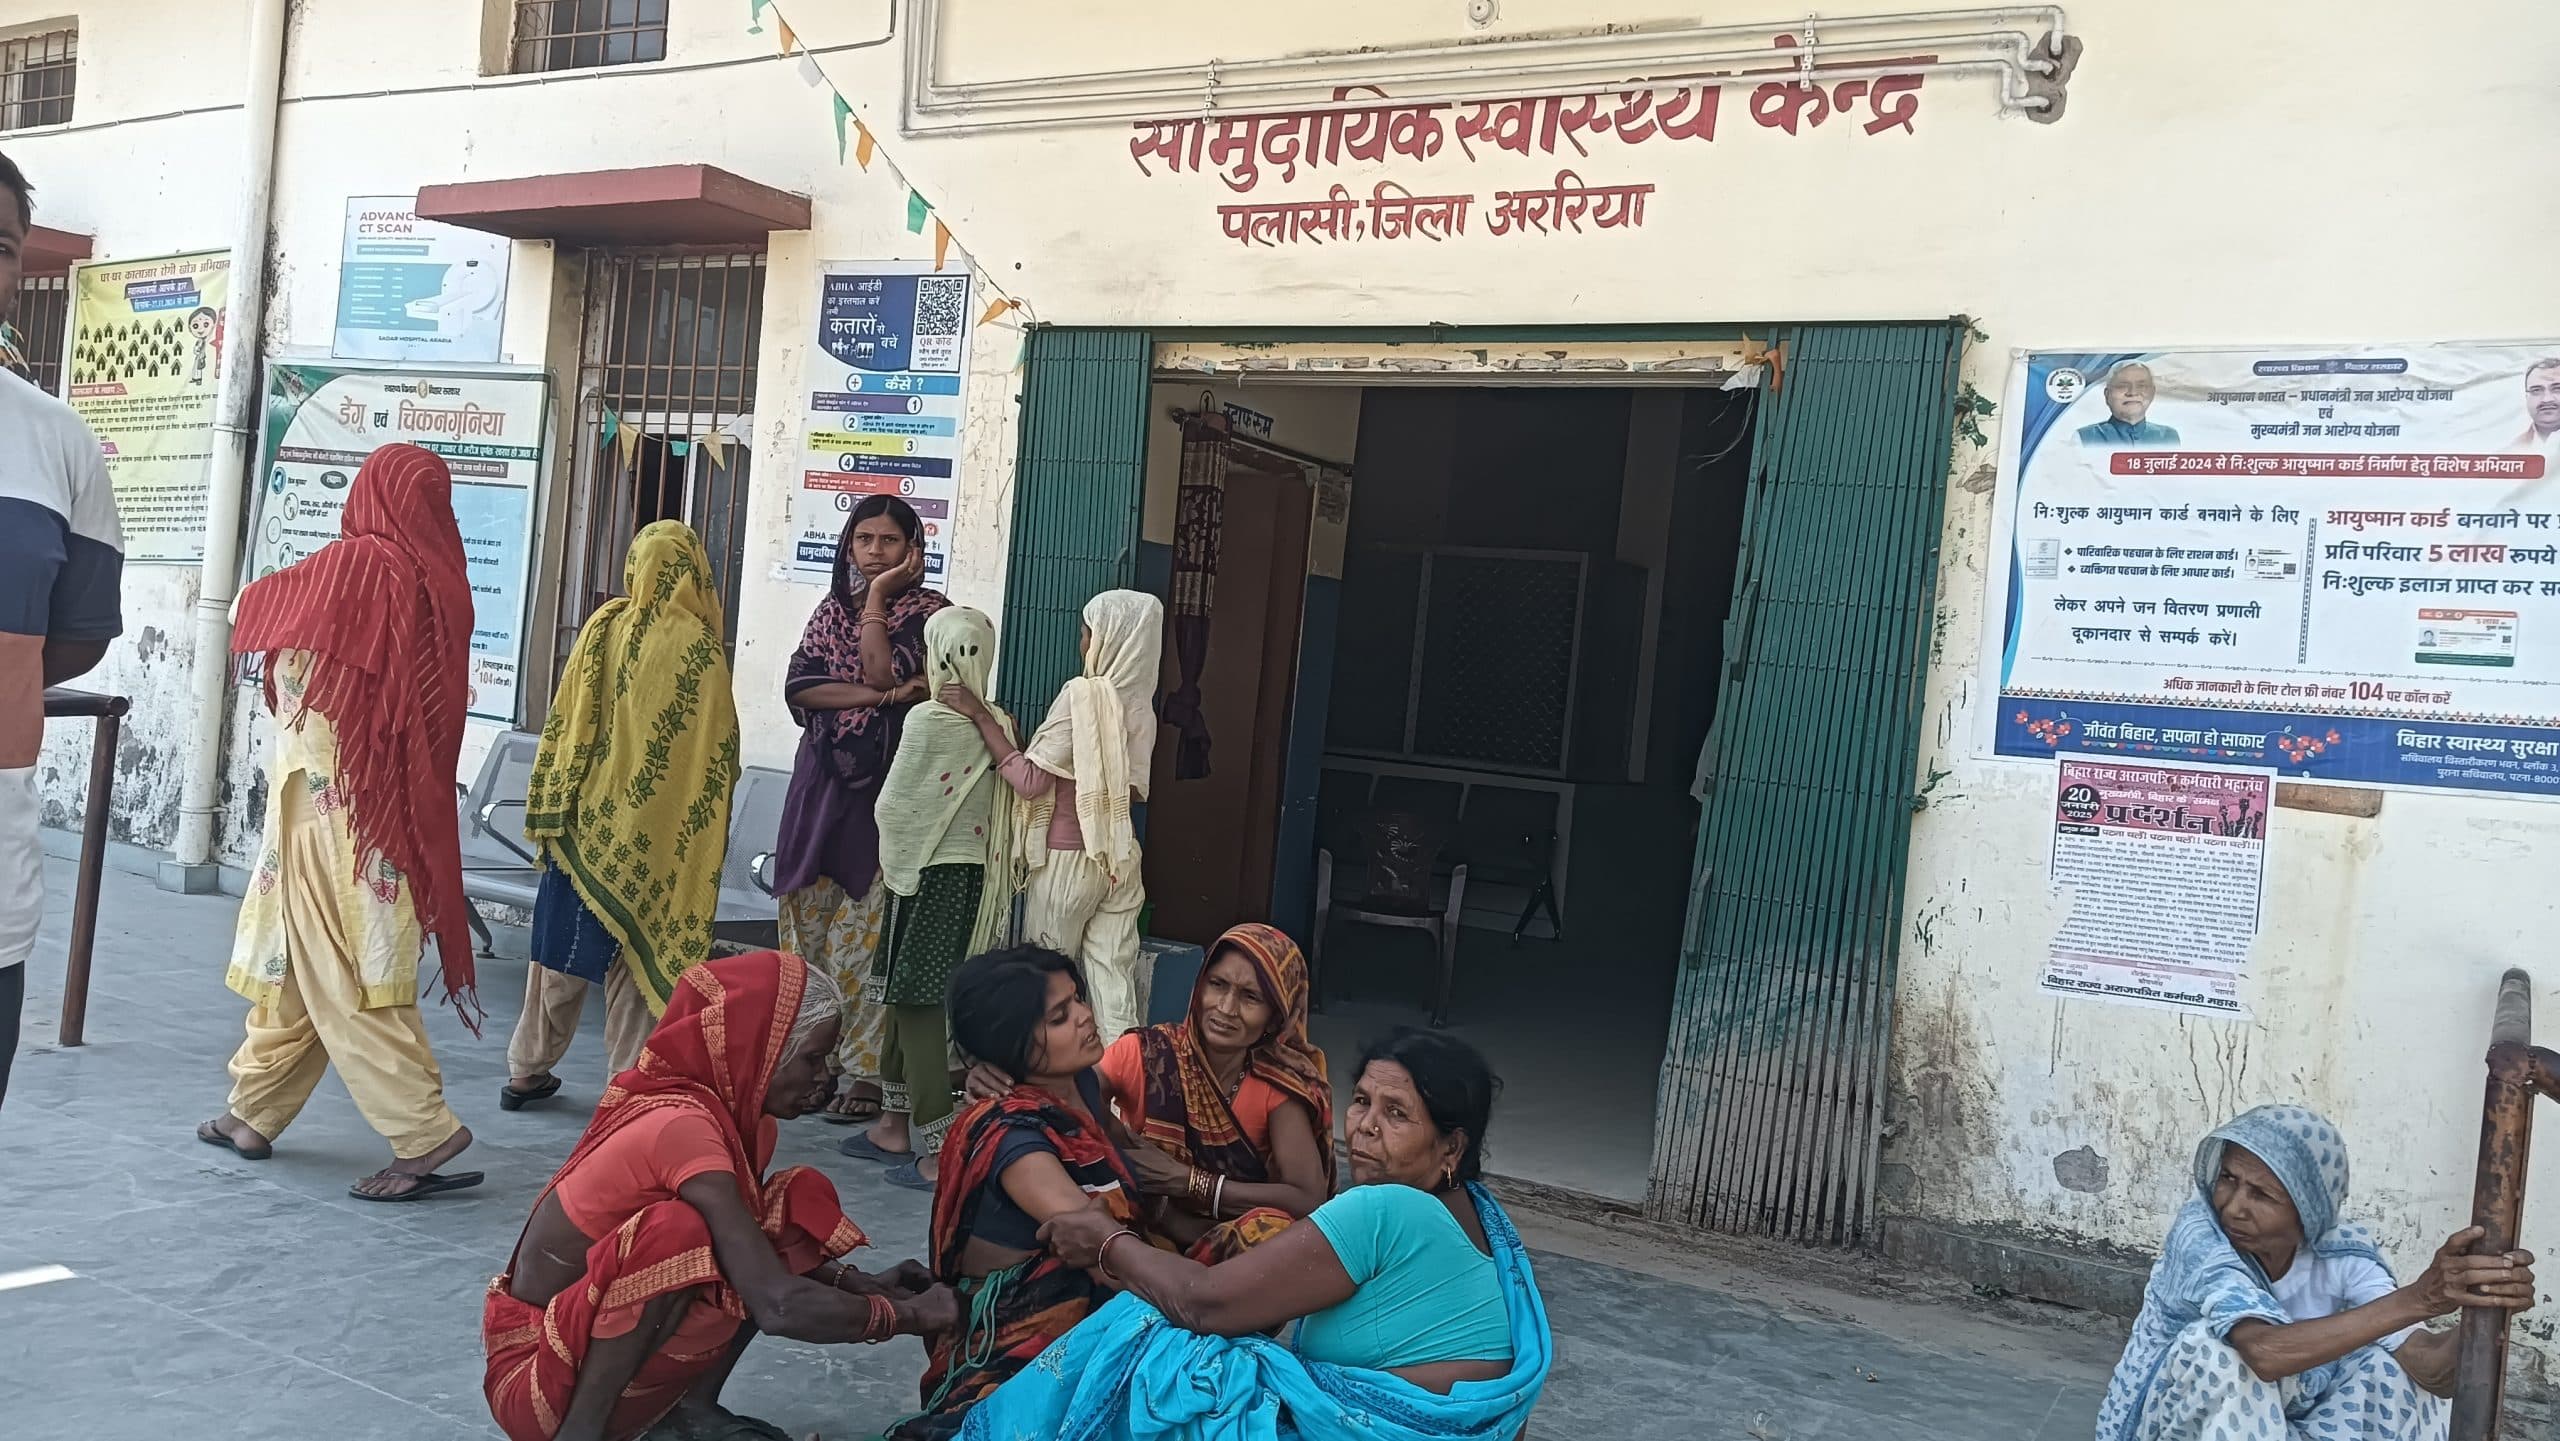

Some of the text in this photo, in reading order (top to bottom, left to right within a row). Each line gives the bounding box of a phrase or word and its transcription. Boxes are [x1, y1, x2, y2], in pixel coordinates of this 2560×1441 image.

[1130, 85, 1452, 193] सामुदायिक
[1366, 181, 1474, 241] जिला
[1486, 169, 1654, 235] अररिया
[359, 224, 412, 233] CT SCAN
[830, 312, 878, 336] कतारों
[920, 338, 932, 346] QR
[2207, 387, 2453, 406] आयुष्मान भारत प्रधानमंत्री जन आरोग्य योजना
[338, 396, 506, 440] डेंगू एवं चिकनगुनिया
[2318, 406, 2334, 419] एवं
[2250, 421, 2400, 440] मुख्यमंत्री जन आरोग्य योजना
[844, 458, 851, 468] 4
[2127, 459, 2140, 469] 18
[2144, 454, 2177, 474] जुलाई
[2180, 459, 2212, 469] 2024
[2214, 455, 2227, 470] से
[2281, 458, 2334, 474] आयुष्मान
[2338, 456, 2365, 471] कार्ड
[2368, 456, 2407, 472] निर्माण
[2411, 458, 2430, 476] हेतु
[2433, 456, 2470, 472] विशेष
[2473, 458, 2525, 473] अभियान
[903, 481, 909, 492] 5
[841, 497, 847, 508] 6
[2096, 506, 2152, 524] आयुष्मान
[2160, 503, 2190, 521] कार्ड
[2198, 505, 2242, 522] बनवाने
[2249, 505, 2263, 522] के
[2271, 505, 2299, 525] लिए
[2326, 507, 2552, 531] आयुष्मान कार्ड बनवाने पर
[803, 532, 826, 540] ABHA
[2077, 545, 2121, 558] पारिवारिक
[2123, 547, 2153, 559] पहचान
[2155, 545, 2163, 558] के
[2166, 546, 2184, 560] लिए
[2187, 549, 2213, 560] राशन
[2325, 540, 2363, 560] प्रति
[2363, 541, 2422, 562] परिवार
[2428, 545, 2442, 562] 5
[2449, 544, 2507, 562] लाख
[2080, 563, 2116, 575] व्यक्तिगत
[2118, 565, 2148, 576] पहचान
[2150, 563, 2159, 576] के
[2161, 564, 2179, 577] लिए
[2181, 566, 2209, 577] आधार
[2400, 578, 2451, 594] इलाज
[2456, 579, 2498, 595] प्राप्त
[2502, 581, 2534, 596] कर
[2054, 594, 2261, 619] लेकर अपने जन वितरण प्रणाली
[2072, 626, 2131, 644] दूकानदार
[2139, 625, 2151, 642] से
[2158, 627, 2199, 644] सम्पर्क
[2163, 676, 2193, 691] अधिक
[2196, 678, 2242, 694] जानकारी
[2244, 679, 2254, 694] के
[2257, 680, 2278, 696] लिए
[2281, 683, 2301, 696] टोल
[2304, 684, 2319, 698] फ्री
[2349, 681, 2384, 701] 104
[2387, 691, 2402, 702] पर
[2404, 689, 2429, 703] कॉल
[2432, 690, 2452, 705] करें
[2083, 721, 2265, 749] जीवंत बिहार, सपना हो साकार
[2396, 728, 2559, 759] बिहार स्वास्थ्य सुरक्षा
[2063, 763, 2092, 778] बिहार
[2093, 768, 2116, 780] राज्य
[2180, 774, 2221, 789] कर्मचारी
[2068, 788, 2091, 802] 20
[2060, 801, 2100, 811] जनवरी
[2067, 811, 2092, 819] 2025
[2104, 803, 2217, 834] प्रदर्शन
[2048, 975, 2074, 986] बिहार
[2077, 980, 2101, 990] राज्य
